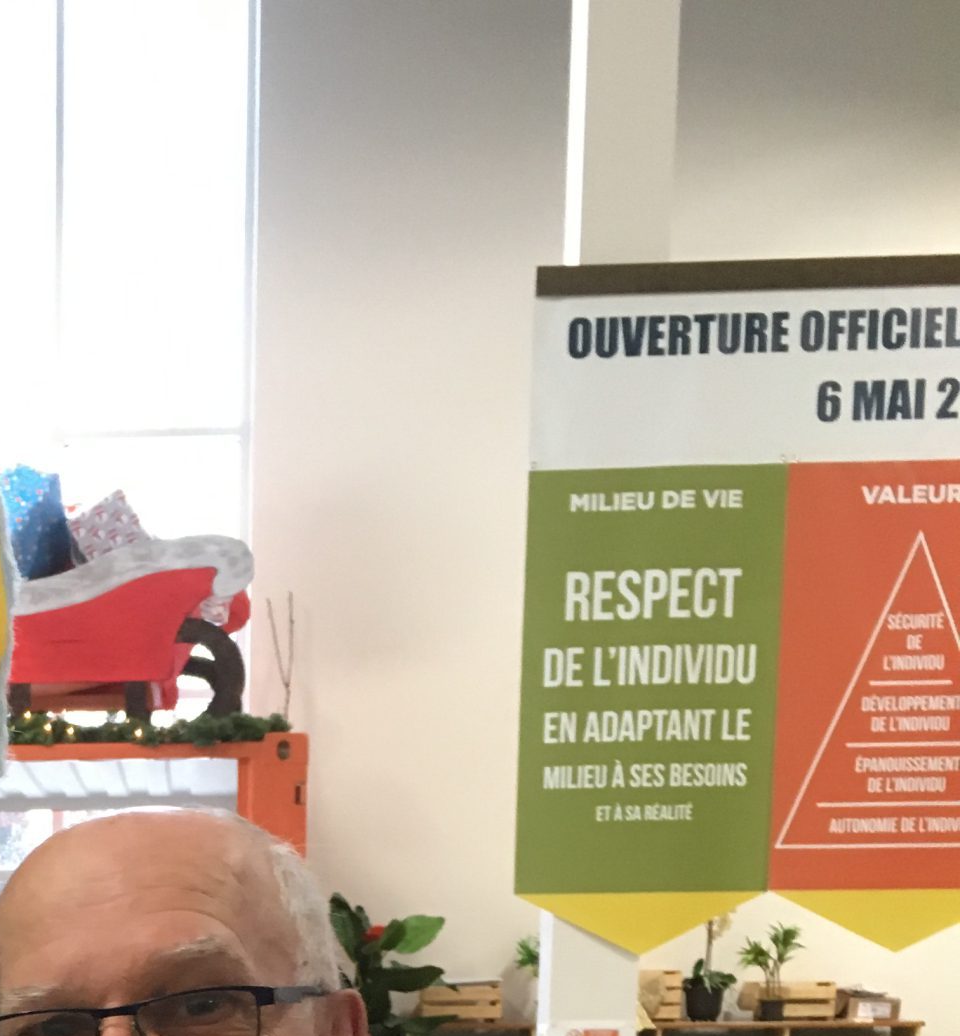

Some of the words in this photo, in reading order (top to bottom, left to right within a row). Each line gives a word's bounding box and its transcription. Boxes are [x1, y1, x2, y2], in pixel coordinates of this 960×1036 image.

[567, 311, 790, 358] OUVERTURE
[800, 307, 960, 352] OFFICIEL
[816, 380, 842, 422] 6
[852, 378, 926, 421] MAI
[936, 377, 960, 419] 2
[570, 491, 655, 512] MILIEU
[661, 489, 696, 510] DE
[703, 488, 743, 509] VIE
[565, 567, 743, 621] RESPECT
[887, 610, 944, 630] SÉCURITÉ
[906, 634, 923, 650] DE
[543, 646, 585, 688] DE
[593, 643, 757, 686] L'INDIVIDU
[883, 654, 945, 671] L'INDIVIDU
[543, 711, 577, 744] EN
[582, 709, 716, 743] ADAPTANT
[721, 708, 753, 741] LE
[870, 716, 887, 732] DE
[889, 715, 951, 732] L'INDIVIDU
[543, 764, 608, 789] MILIEU
[611, 759, 625, 788] À
[629, 763, 665, 787] SES
[669, 762, 748, 787] BESOINS
[867, 777, 883, 793] DE
[886, 776, 947, 793] L'INDIVIDU
[596, 805, 612, 822] ET
[613, 803, 624, 821] À
[625, 804, 642, 821] SA
[644, 801, 693, 821] RÉALITÉ
[829, 817, 898, 833] AUTONOMIE
[901, 817, 916, 832] DE
